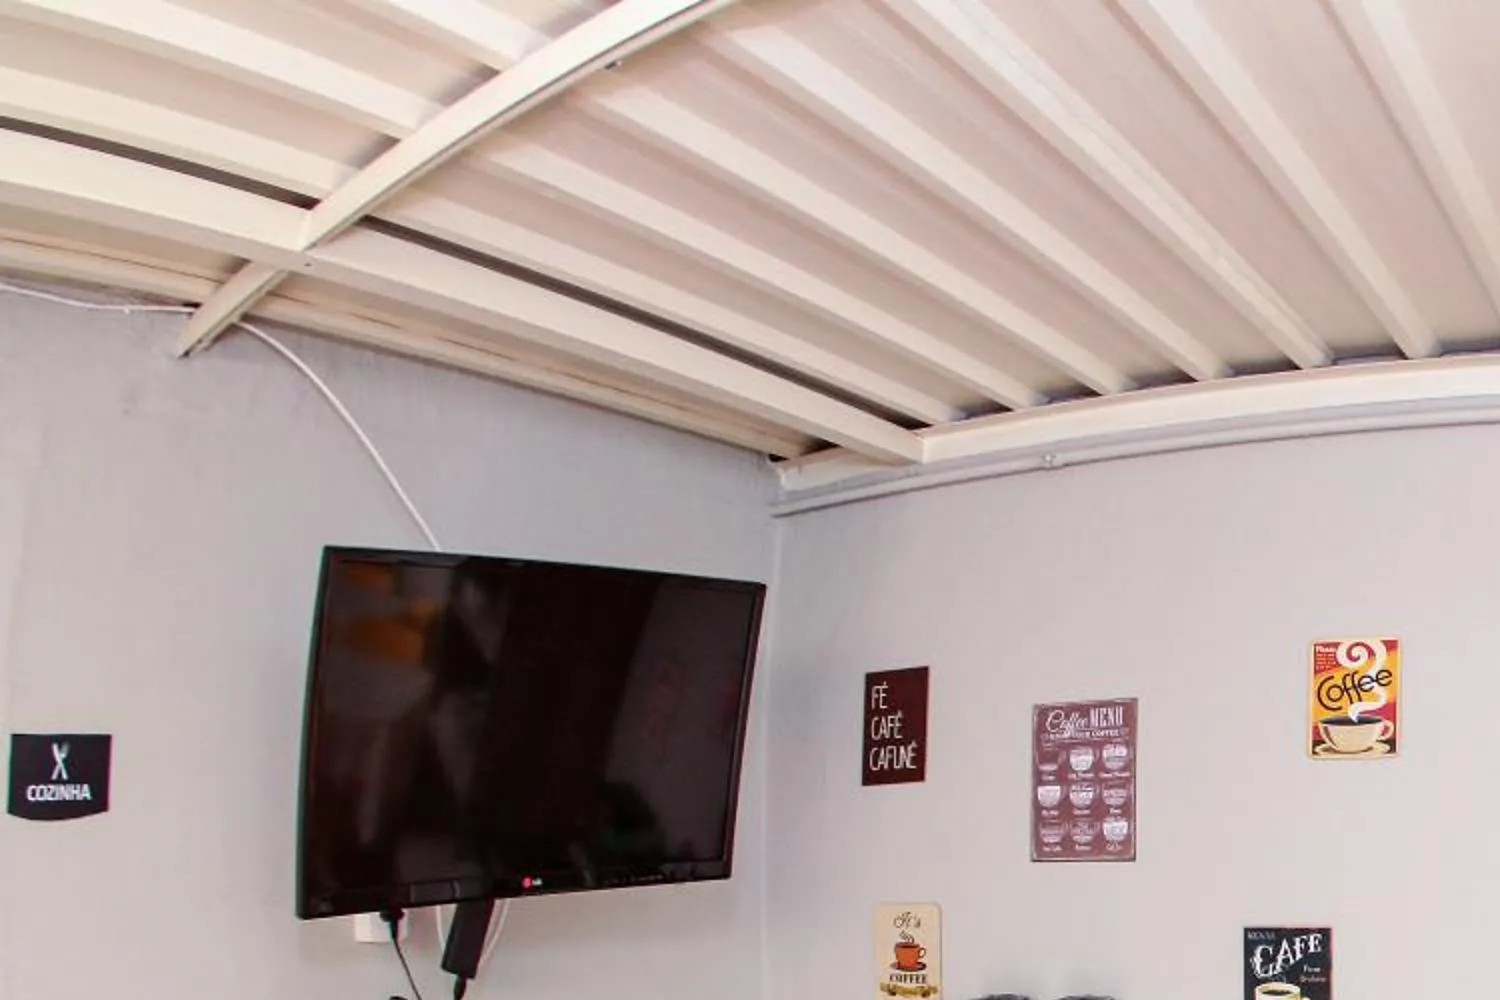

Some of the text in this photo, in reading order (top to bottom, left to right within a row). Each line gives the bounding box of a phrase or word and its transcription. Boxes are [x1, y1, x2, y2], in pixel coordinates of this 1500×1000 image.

[1317, 668, 1393, 712] Coffee
[871, 709, 903, 741] CAFÉ
[1046, 706, 1123, 737] Coffee MENU
[869, 740, 918, 771] CAFUNÉ
[26, 783, 92, 802] COZINHA
[1249, 933, 1323, 979] CAFE
[889, 973, 927, 985] COFFEE
